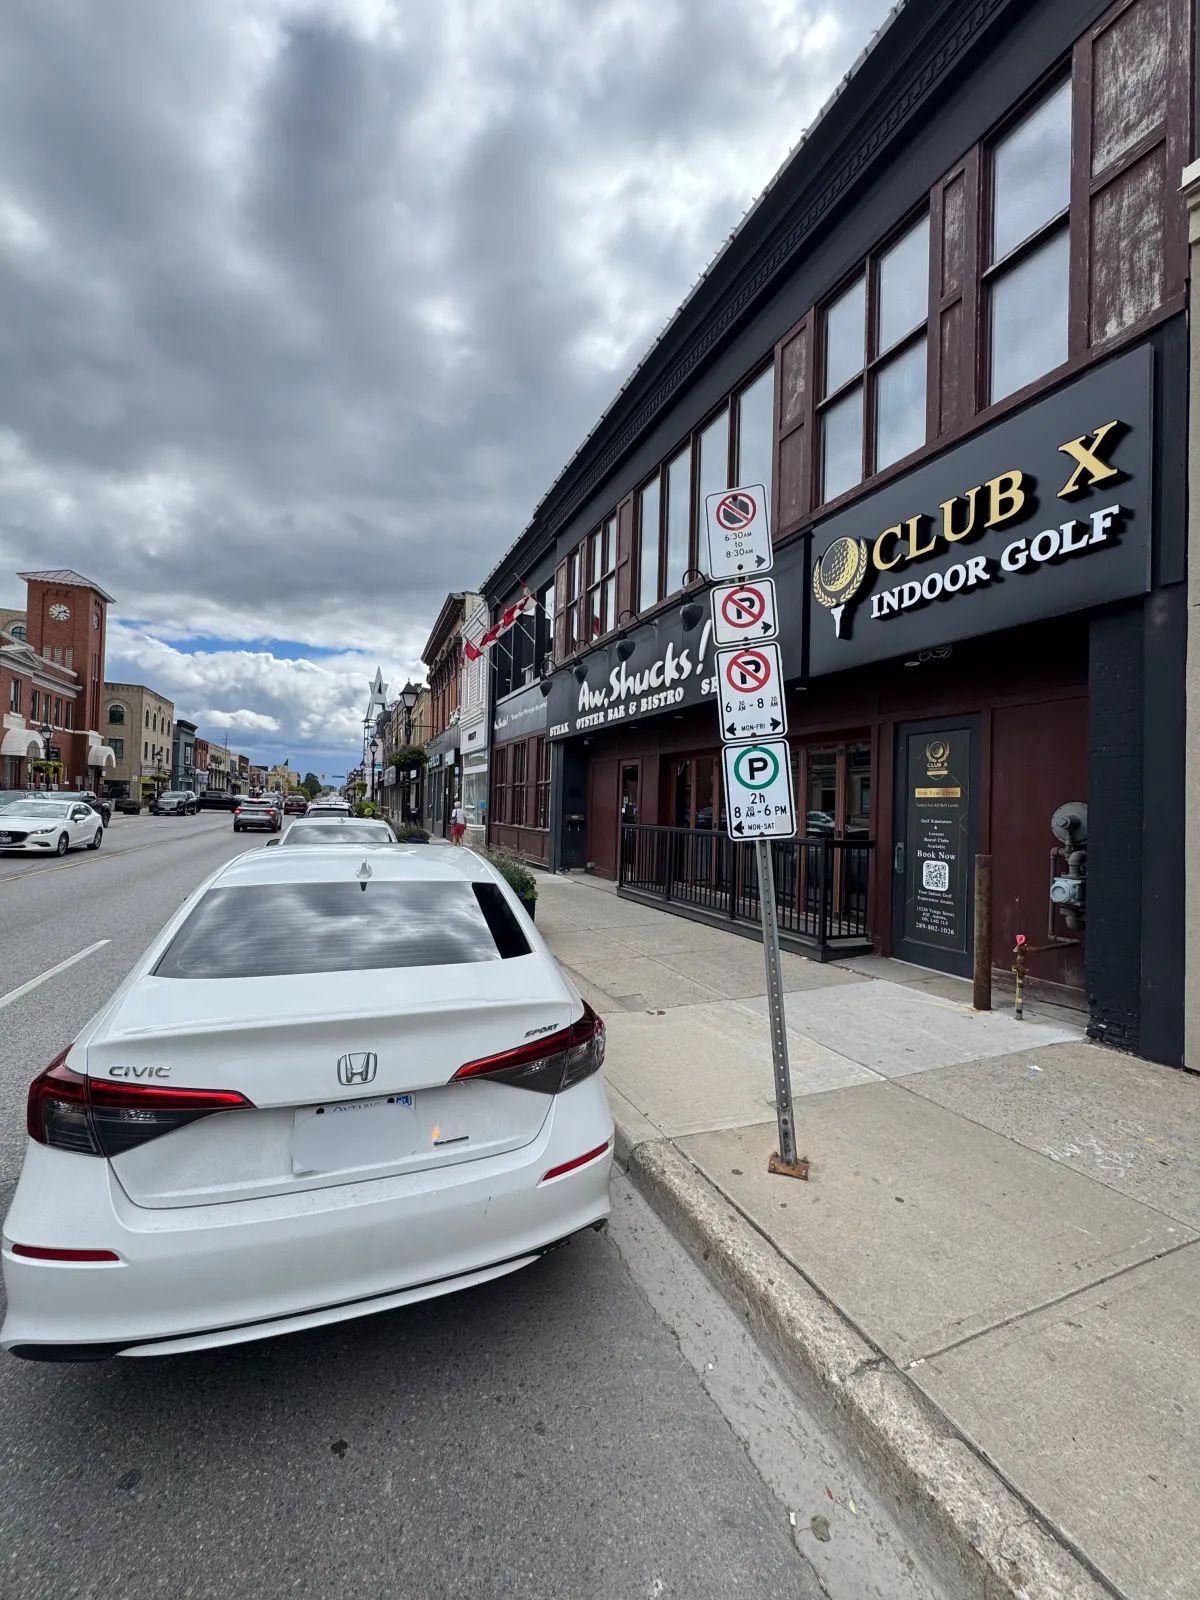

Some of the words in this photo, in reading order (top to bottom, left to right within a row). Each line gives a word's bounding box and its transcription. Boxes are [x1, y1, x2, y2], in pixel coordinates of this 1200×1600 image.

[872, 469, 1025, 571] CLUB
[1057, 420, 1118, 498] X
[724, 531, 752, 542] 6:30AM
[725, 548, 754, 559] 8:30AM
[870, 556, 990, 619] INDOOR
[1000, 504, 1120, 573] GOLF
[609, 619, 711, 701] Shucks!
[549, 722, 570, 737] STEAK
[576, 711, 605, 730] OYSTER
[607, 704, 625, 722] BAR
[629, 701, 637, 715] &
[640, 687, 684, 712] BISTRO
[725, 702, 732, 713] 6
[757, 697, 764, 709] 8
[741, 723, 766, 732] MON-FRI
[734, 806, 741, 819] 8
[764, 804, 772, 816] 6
[775, 805, 788, 815] PM
[747, 822, 775, 831] MON-SAT
[917, 850, 936, 858] Book
[938, 851, 956, 860] Now
[915, 921, 955, 935] 289-802-1026
[524, 1022, 560, 1038] SPORT
[108, 1066, 172, 1078] CIVIC
